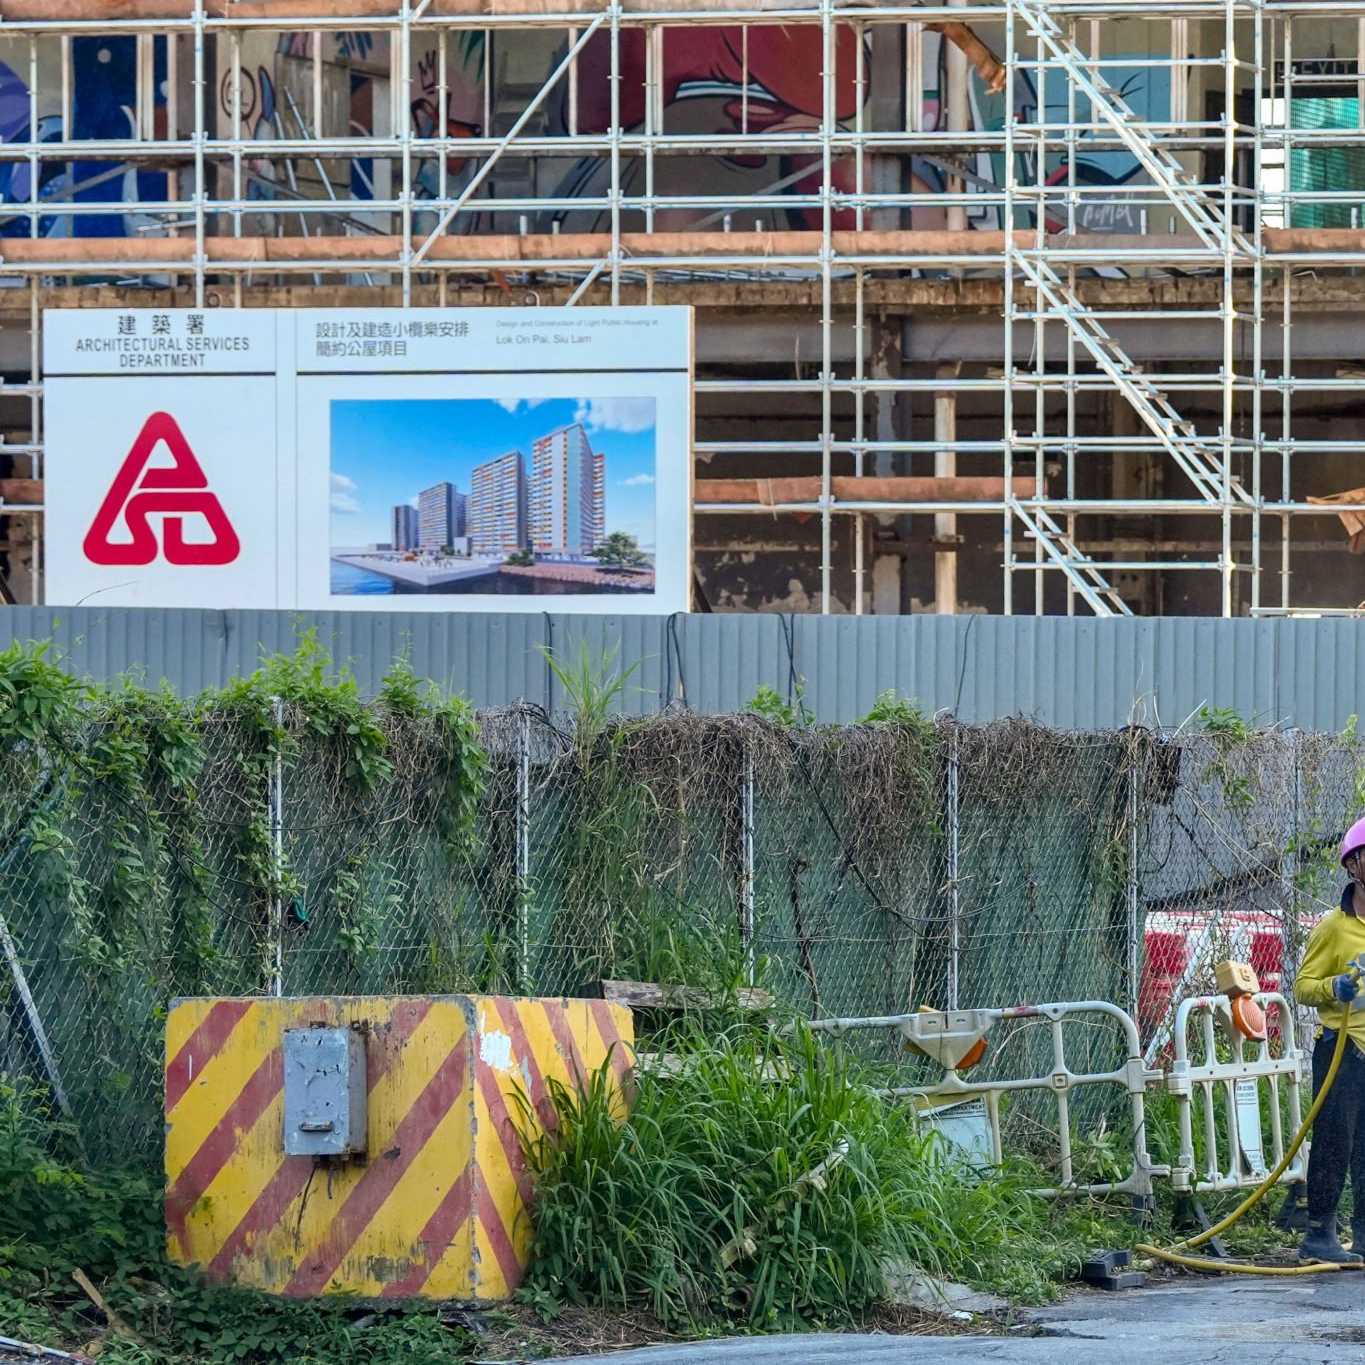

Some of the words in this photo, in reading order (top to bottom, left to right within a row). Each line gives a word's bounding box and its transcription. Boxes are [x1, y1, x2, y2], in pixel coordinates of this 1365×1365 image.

[118, 315, 204, 335] 建築署
[76, 338, 182, 351] ARCHITECTURAL
[186, 337, 250, 350] SERVICES
[496, 335, 513, 345] Lok
[516, 335, 530, 345] On
[553, 334, 569, 344] Siu
[571, 334, 592, 344] Lam
[316, 341, 407, 357] 簡約公屋項目
[120, 354, 205, 367] DEPARTMENT
